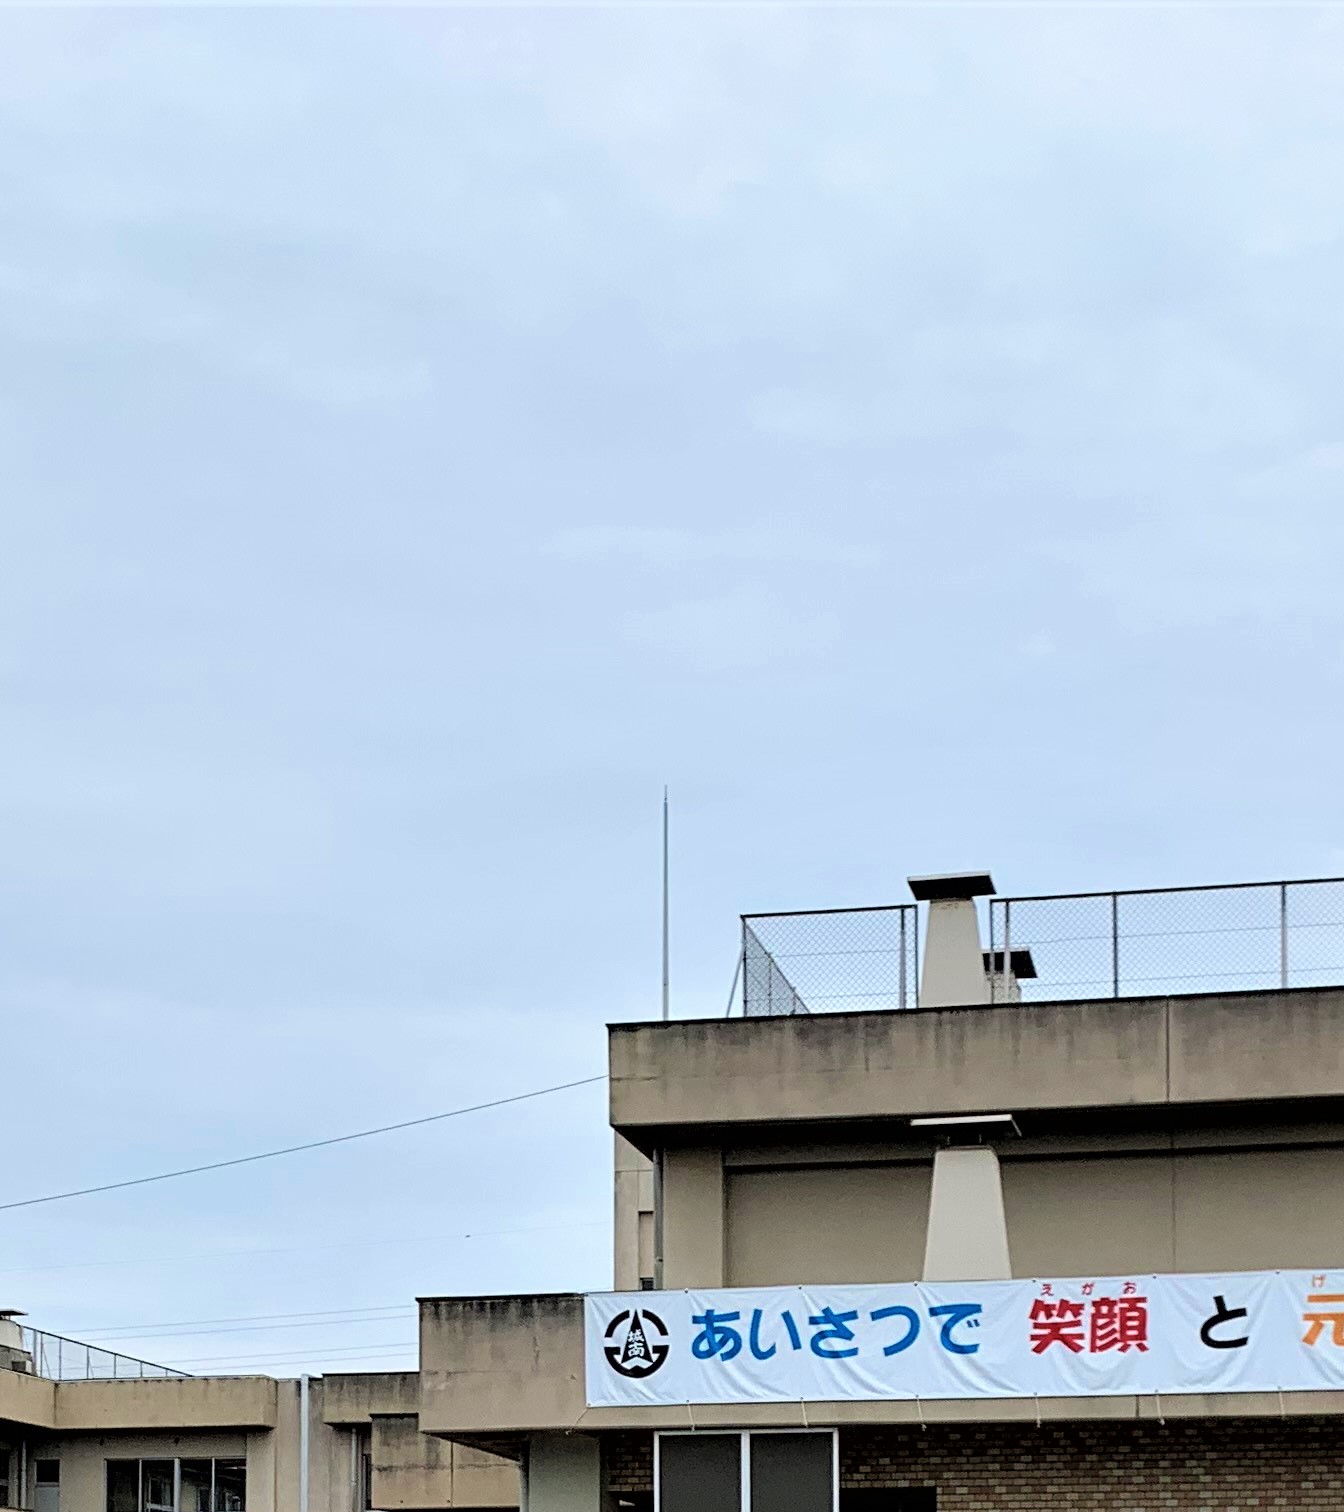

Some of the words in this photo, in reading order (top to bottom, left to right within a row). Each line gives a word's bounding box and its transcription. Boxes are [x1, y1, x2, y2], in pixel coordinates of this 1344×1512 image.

[1040, 1281, 1137, 1296] えがお
[691, 1303, 983, 1362] あいさつで
[1028, 1297, 1150, 1355] 笑顔
[1200, 1295, 1249, 1348] と
